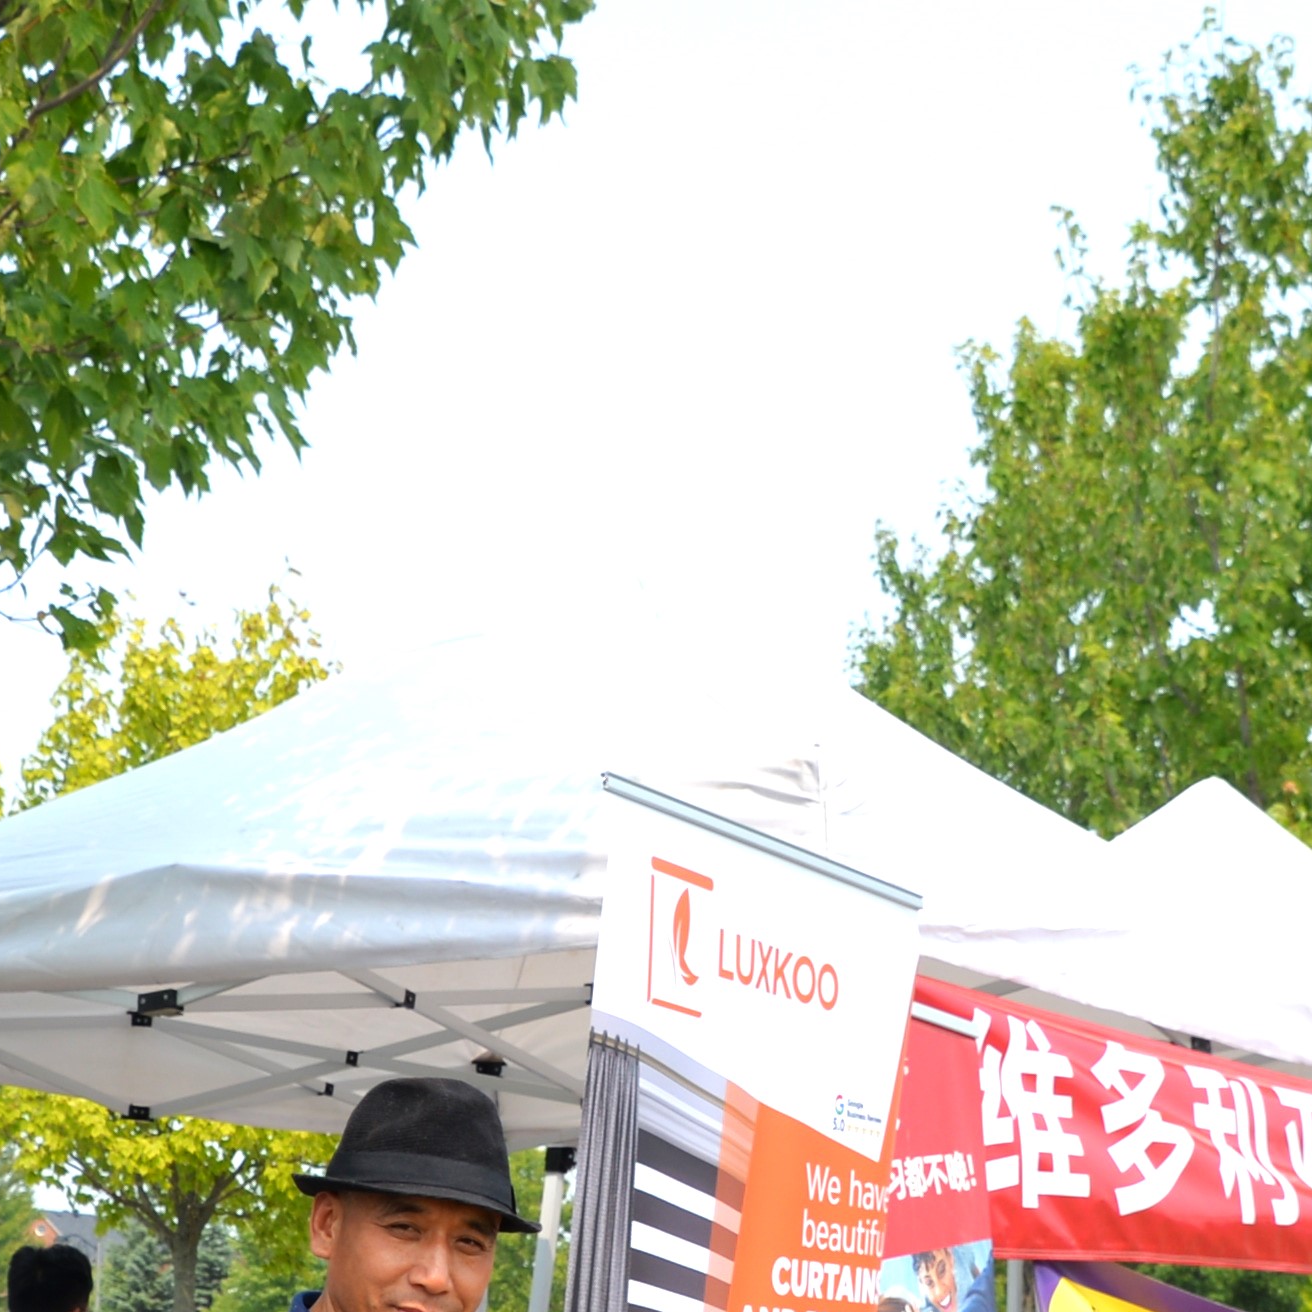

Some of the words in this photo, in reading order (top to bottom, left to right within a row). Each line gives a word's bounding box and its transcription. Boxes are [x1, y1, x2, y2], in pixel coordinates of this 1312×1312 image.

[718, 928, 839, 1011] LUXKOO
[805, 1162, 842, 1206] We
[849, 1167, 890, 1214] have
